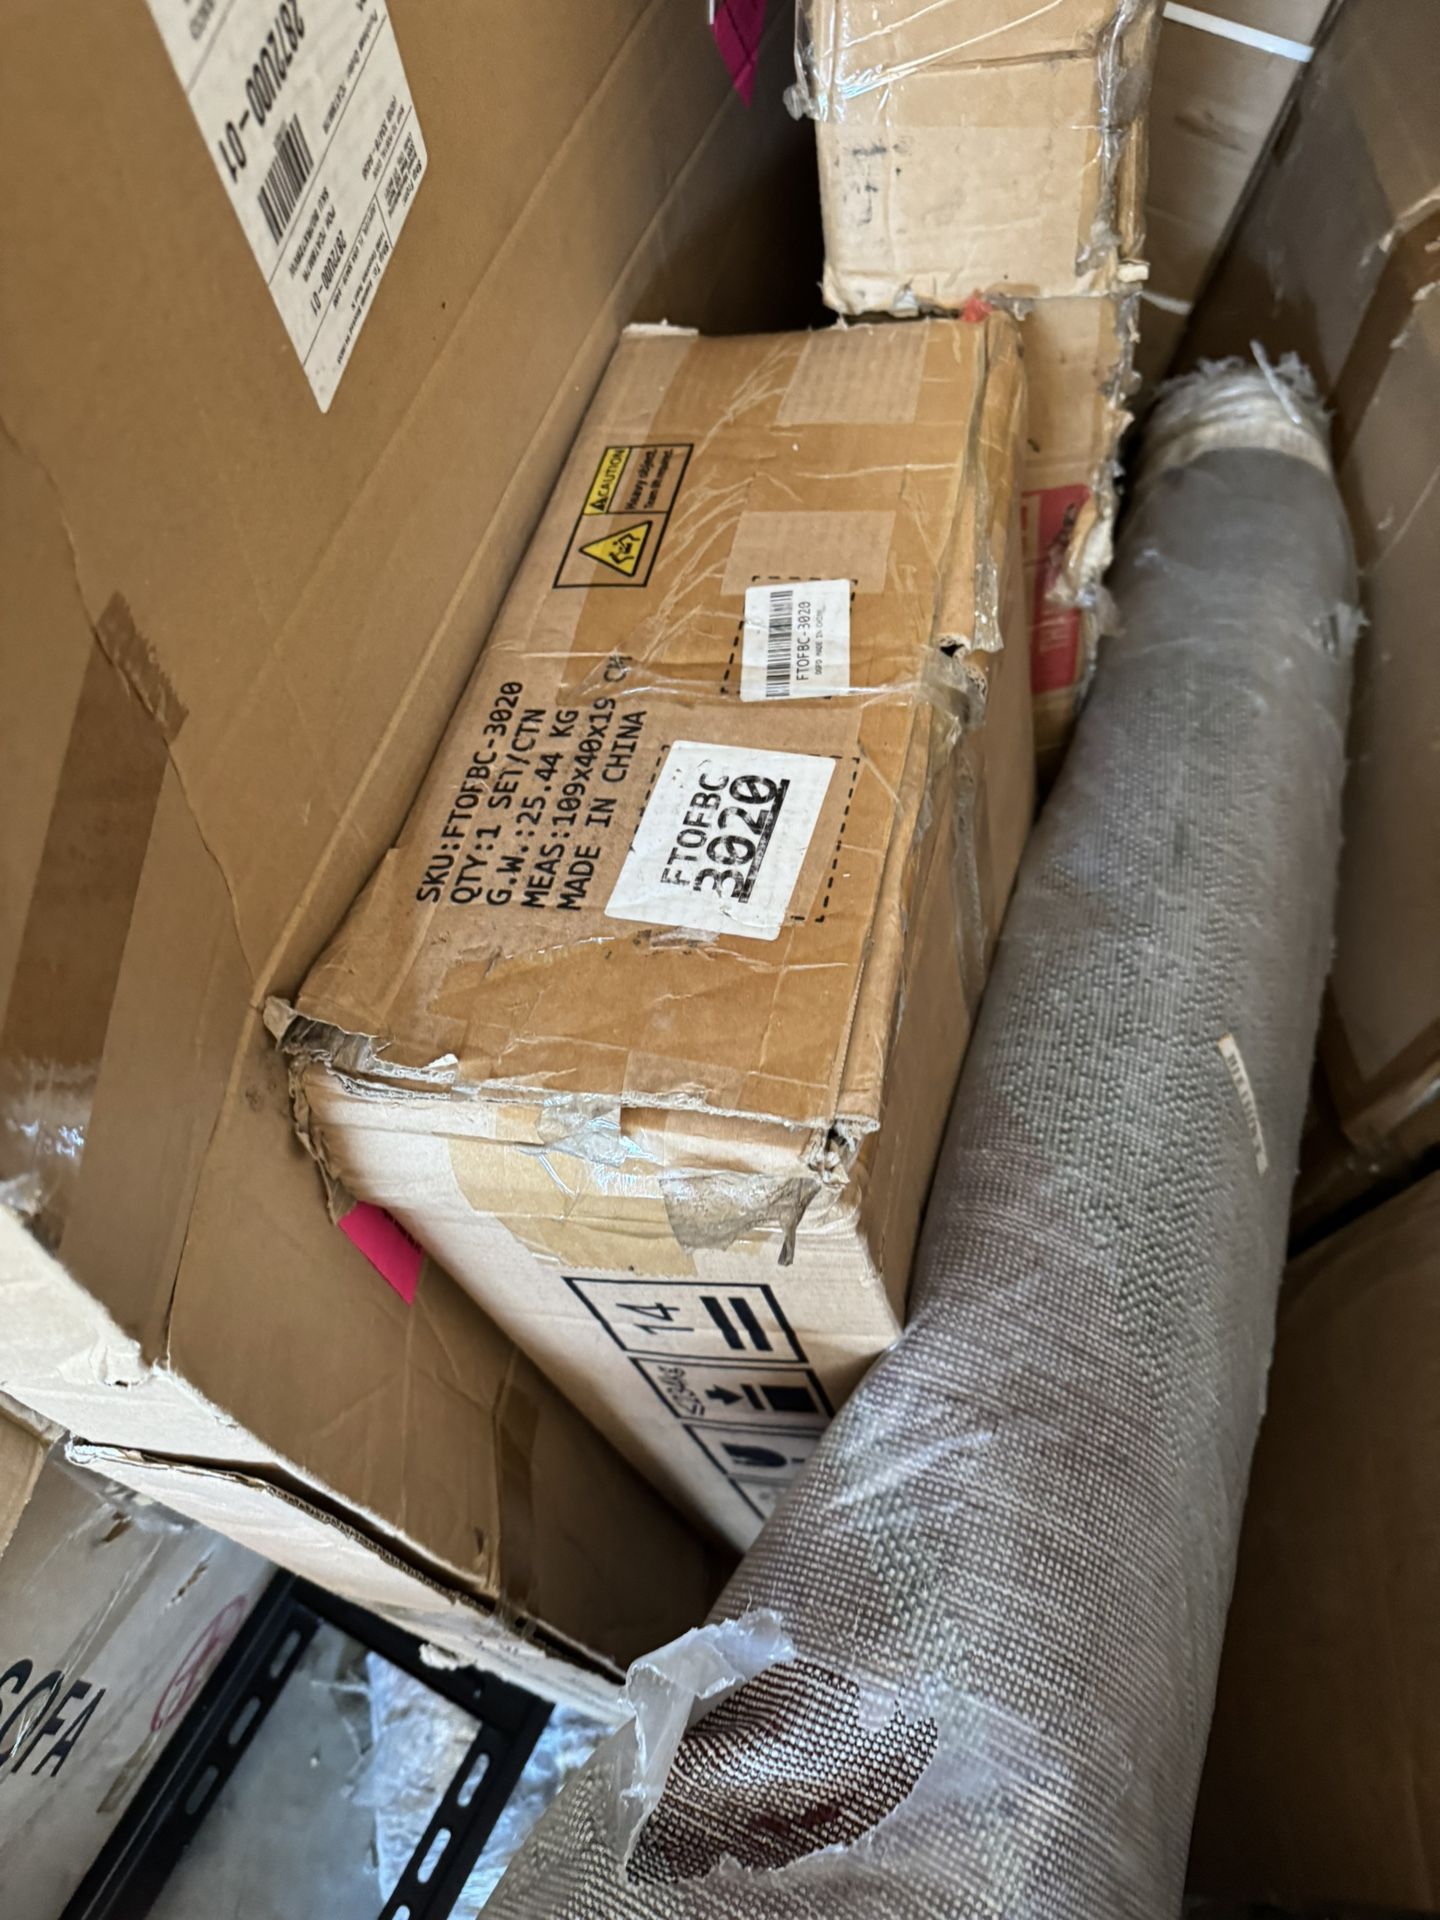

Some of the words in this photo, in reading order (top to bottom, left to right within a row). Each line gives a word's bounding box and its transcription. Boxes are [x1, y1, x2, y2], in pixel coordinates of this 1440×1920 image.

[218, 0, 305, 184] 2872U00-01
[311, 229, 347, 317] 2872U00-01
[598, 447, 625, 497] CAUTION
[796, 601, 811, 681] FTOFBC-3020
[416, 681, 523, 903] SKU:FTOFBC-3020
[450, 824, 501, 904] QTY:1
[488, 708, 546, 809] SET/CTN
[486, 752, 563, 906] G.W.:25.44
[548, 709, 579, 738] KG
[521, 697, 616, 908] MEAS:109x40x19
[557, 845, 601, 911] MADE
[586, 798, 617, 828] IN
[602, 710, 647, 783] CHINA
[660, 772, 730, 888] FTOFBC
[693, 775, 779, 899] 3020
[616, 1302, 694, 1335] 14
